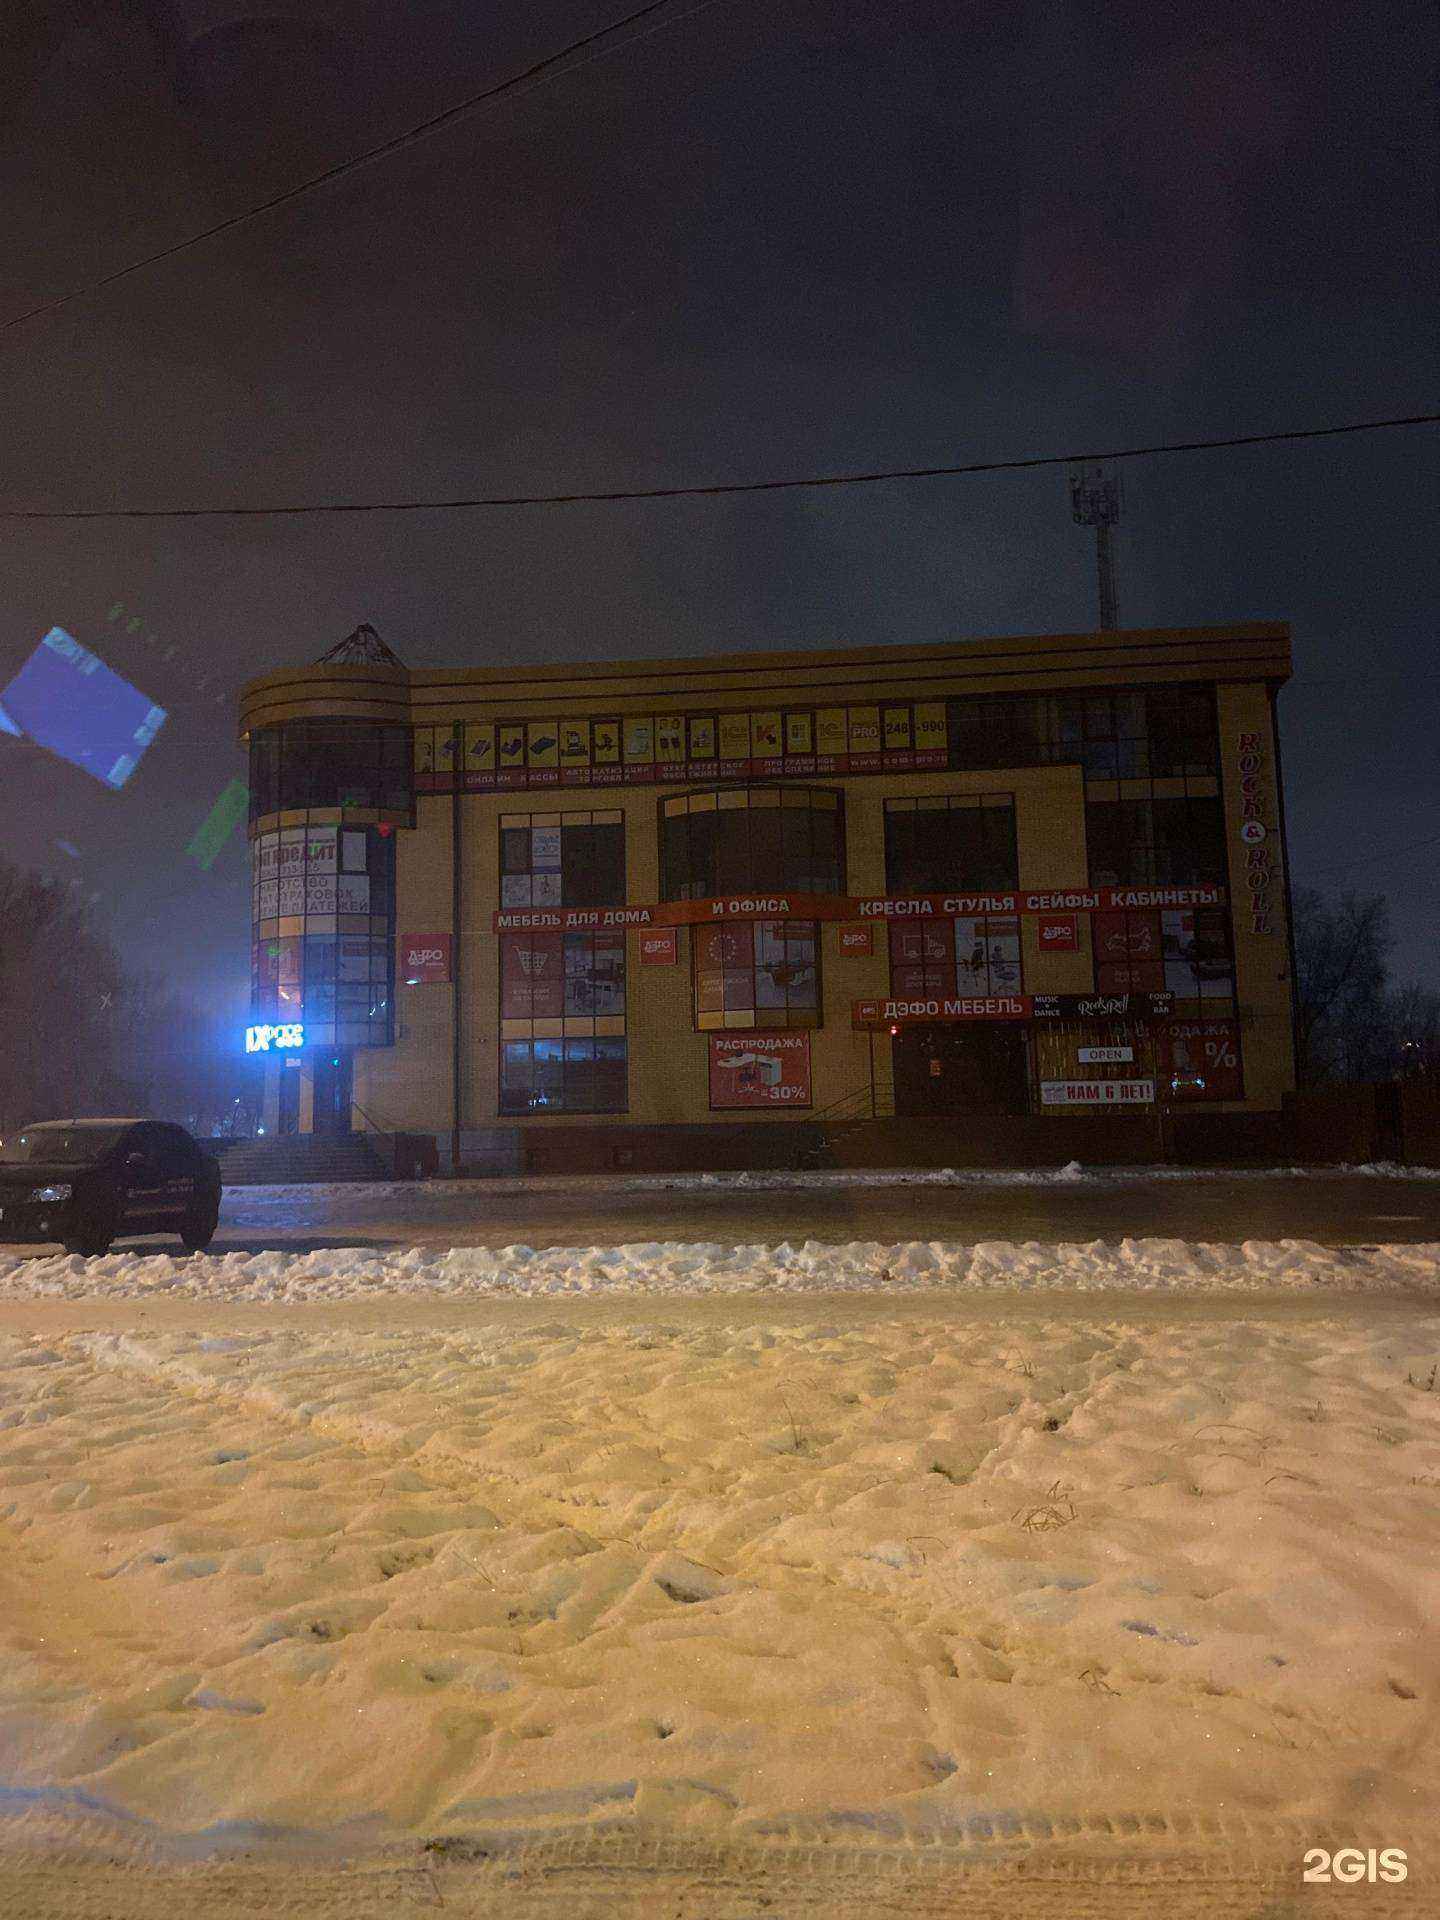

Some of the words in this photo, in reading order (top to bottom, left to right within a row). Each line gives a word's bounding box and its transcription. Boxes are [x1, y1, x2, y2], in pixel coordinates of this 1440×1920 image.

[712, 901, 725, 915] И
[728, 898, 790, 913] ОФИСА
[859, 900, 933, 915] КРЕСЛА
[942, 896, 1015, 912] СТУЛЬЯ
[1026, 892, 1100, 909] СЕЙФЫ
[1110, 889, 1218, 906] КАБИНЕТЫ
[497, 914, 562, 929] МЕБЕЛЬ
[565, 911, 599, 927] ДЛЯ
[603, 909, 651, 926] ДОМА
[1034, 996, 1059, 1004] MUSIC
[884, 1001, 939, 1019] ДЭФО
[943, 997, 1023, 1015] МЕБЕЛЬ
[1034, 1009, 1060, 1017] DANCE
[1153, 1006, 1169, 1014] BAR
[715, 1038, 804, 1051] РАСПРОДАЖА
[1089, 1050, 1123, 1060] OPEN
[1067, 1086, 1100, 1100] НАМ
[1120, 1084, 1151, 1099] ЛЕТ!
